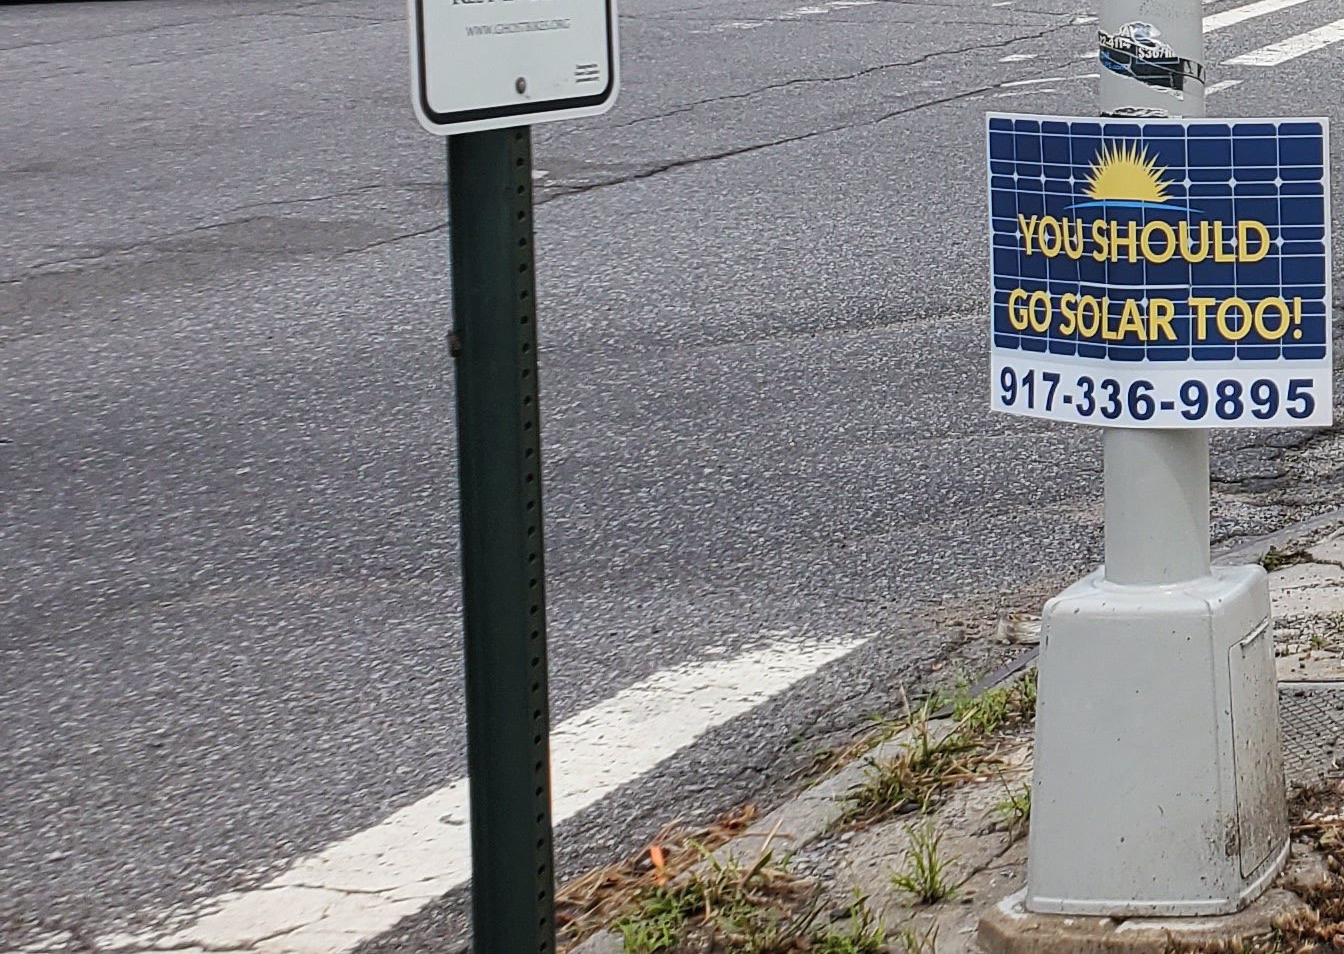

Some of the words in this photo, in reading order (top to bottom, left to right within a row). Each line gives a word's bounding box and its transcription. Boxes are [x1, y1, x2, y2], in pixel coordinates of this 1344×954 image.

[1018, 214, 1084, 259] YOU
[1092, 219, 1270, 263] SHOULD
[1008, 288, 1051, 333] GO
[1059, 293, 1177, 341] SOLAR
[1188, 296, 1302, 341] TOO!
[1000, 366, 1315, 421] 917-336-9895
